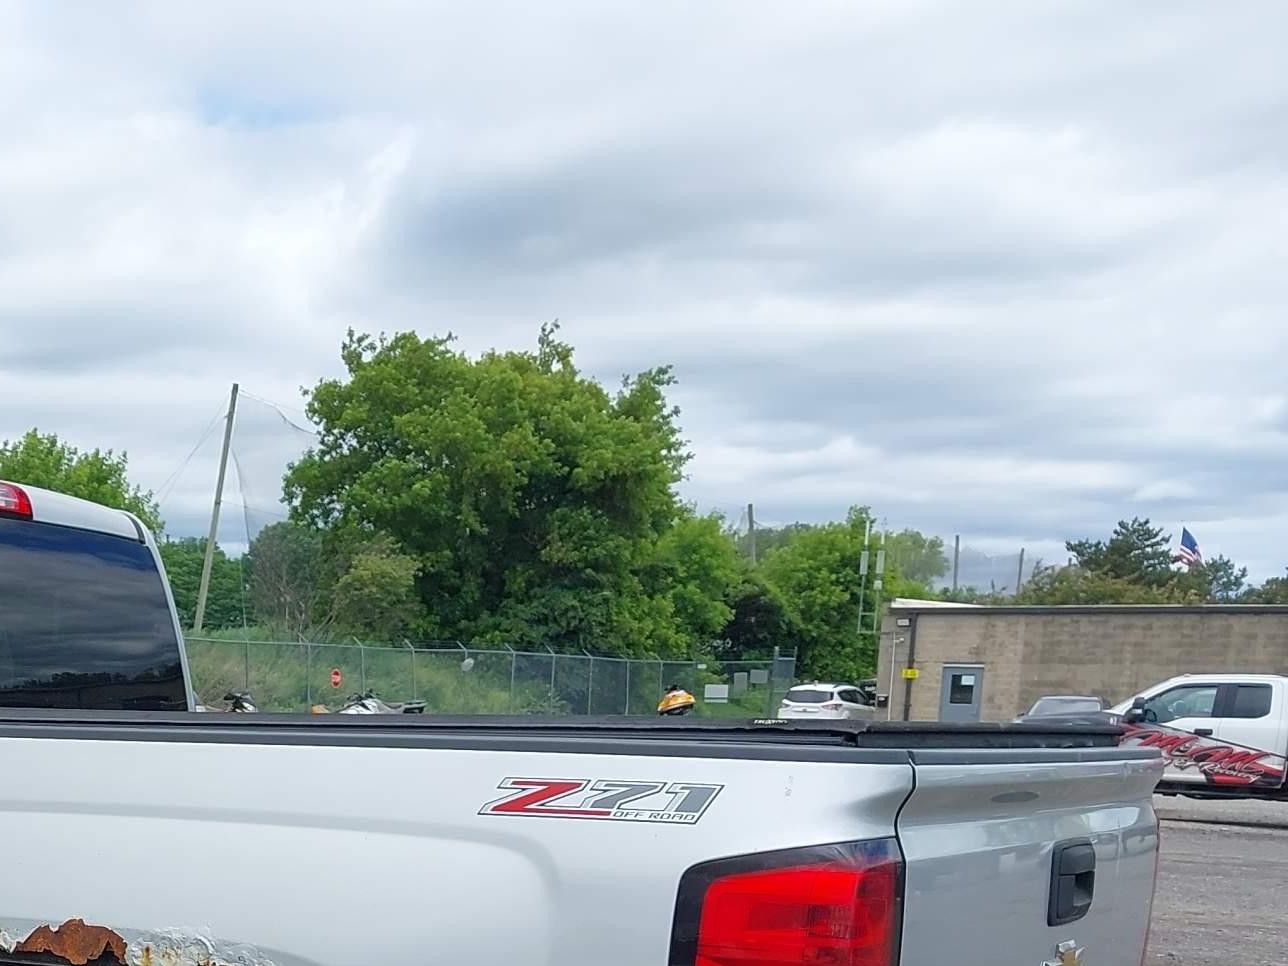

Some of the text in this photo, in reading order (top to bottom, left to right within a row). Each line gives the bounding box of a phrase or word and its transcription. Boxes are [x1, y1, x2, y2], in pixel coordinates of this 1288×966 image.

[477, 777, 725, 823] Z71
[613, 810, 696, 821] OFF ROAD
